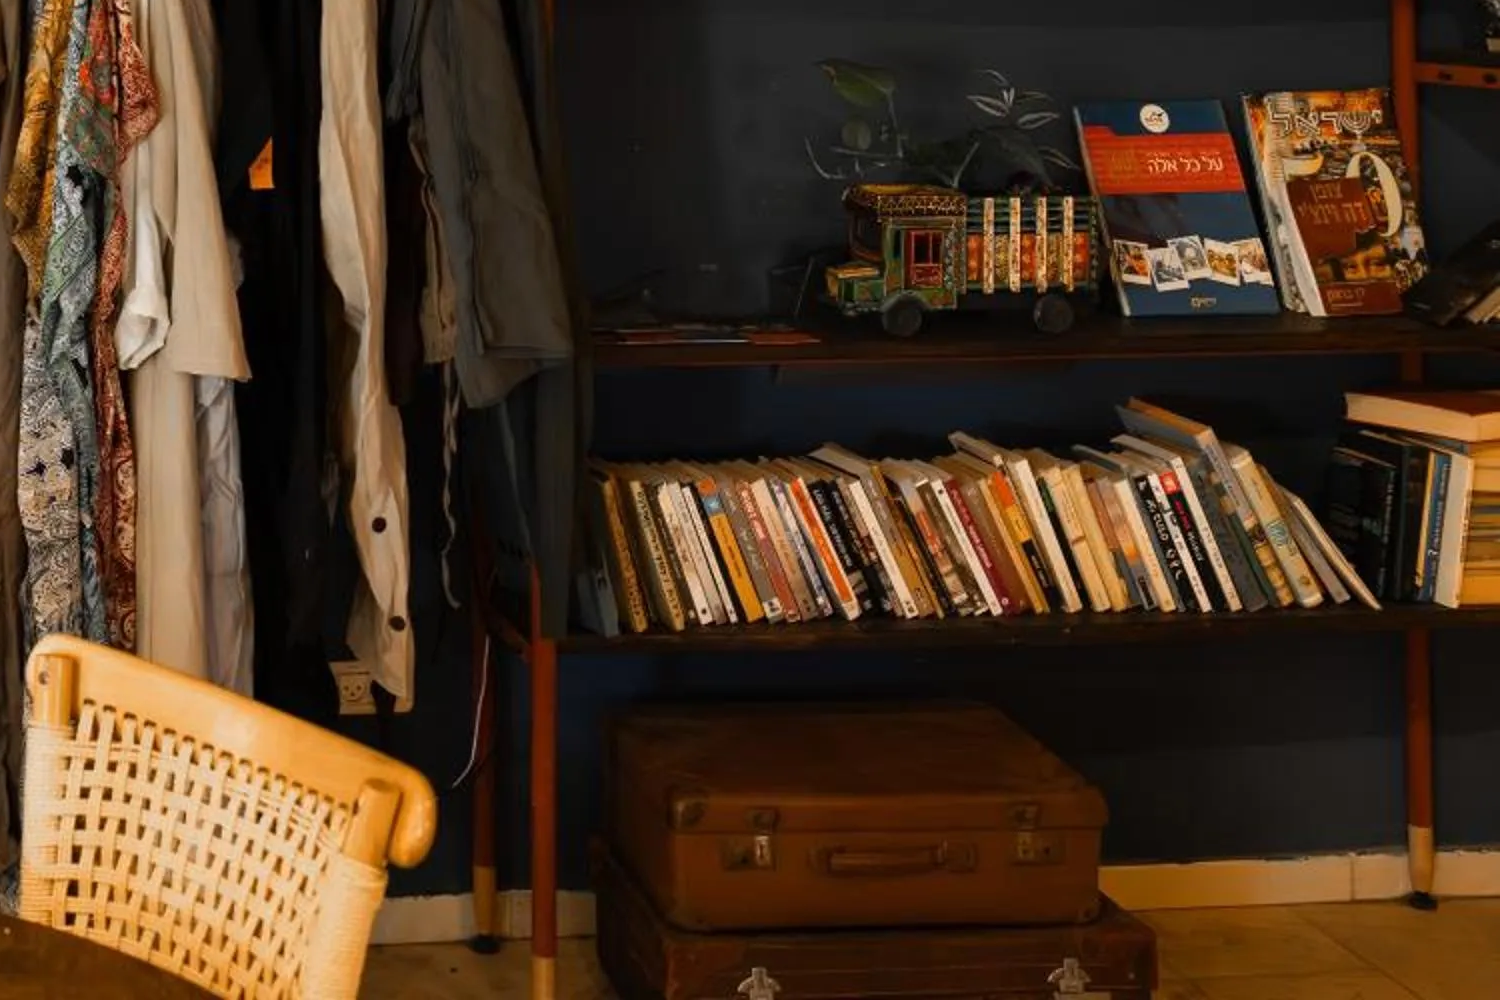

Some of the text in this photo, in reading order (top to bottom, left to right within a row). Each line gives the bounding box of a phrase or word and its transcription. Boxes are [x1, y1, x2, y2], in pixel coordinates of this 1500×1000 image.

[1268, 97, 1384, 142] ישראל
[1148, 156, 1179, 173] אלה
[1180, 156, 1201, 172] כל
[1203, 156, 1224, 172] על
[1311, 182, 1344, 202] צופן
[1342, 201, 1368, 224] דה
